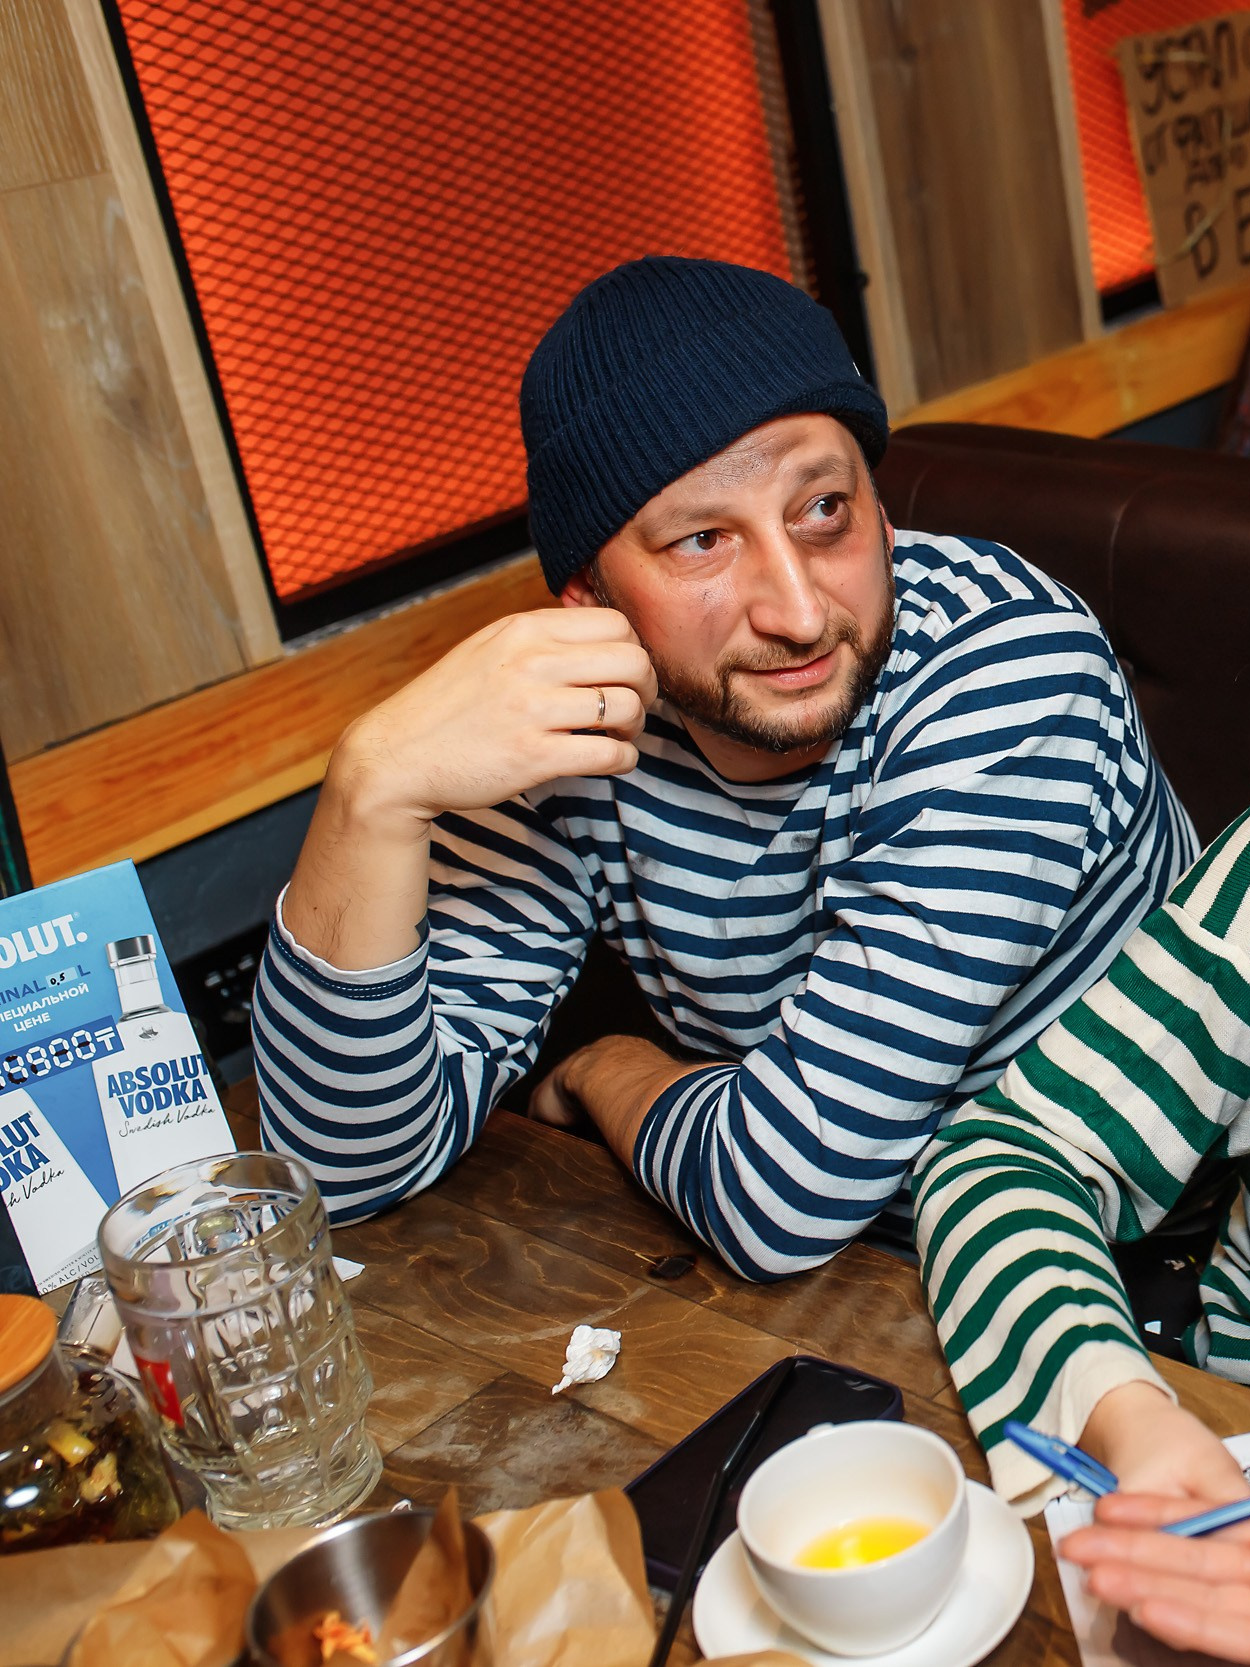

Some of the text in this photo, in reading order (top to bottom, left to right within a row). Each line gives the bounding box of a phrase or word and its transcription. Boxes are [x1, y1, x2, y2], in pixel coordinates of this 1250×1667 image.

[77, 964, 91, 978] L
[13, 1012, 51, 1033] ЦЕНЕ
[107, 1053, 208, 1099] ABSOLUT
[118, 1078, 208, 1119] VODKA
[118, 1104, 216, 1138] Swedish Vodka
[22, 1167, 65, 1200] Vodka
